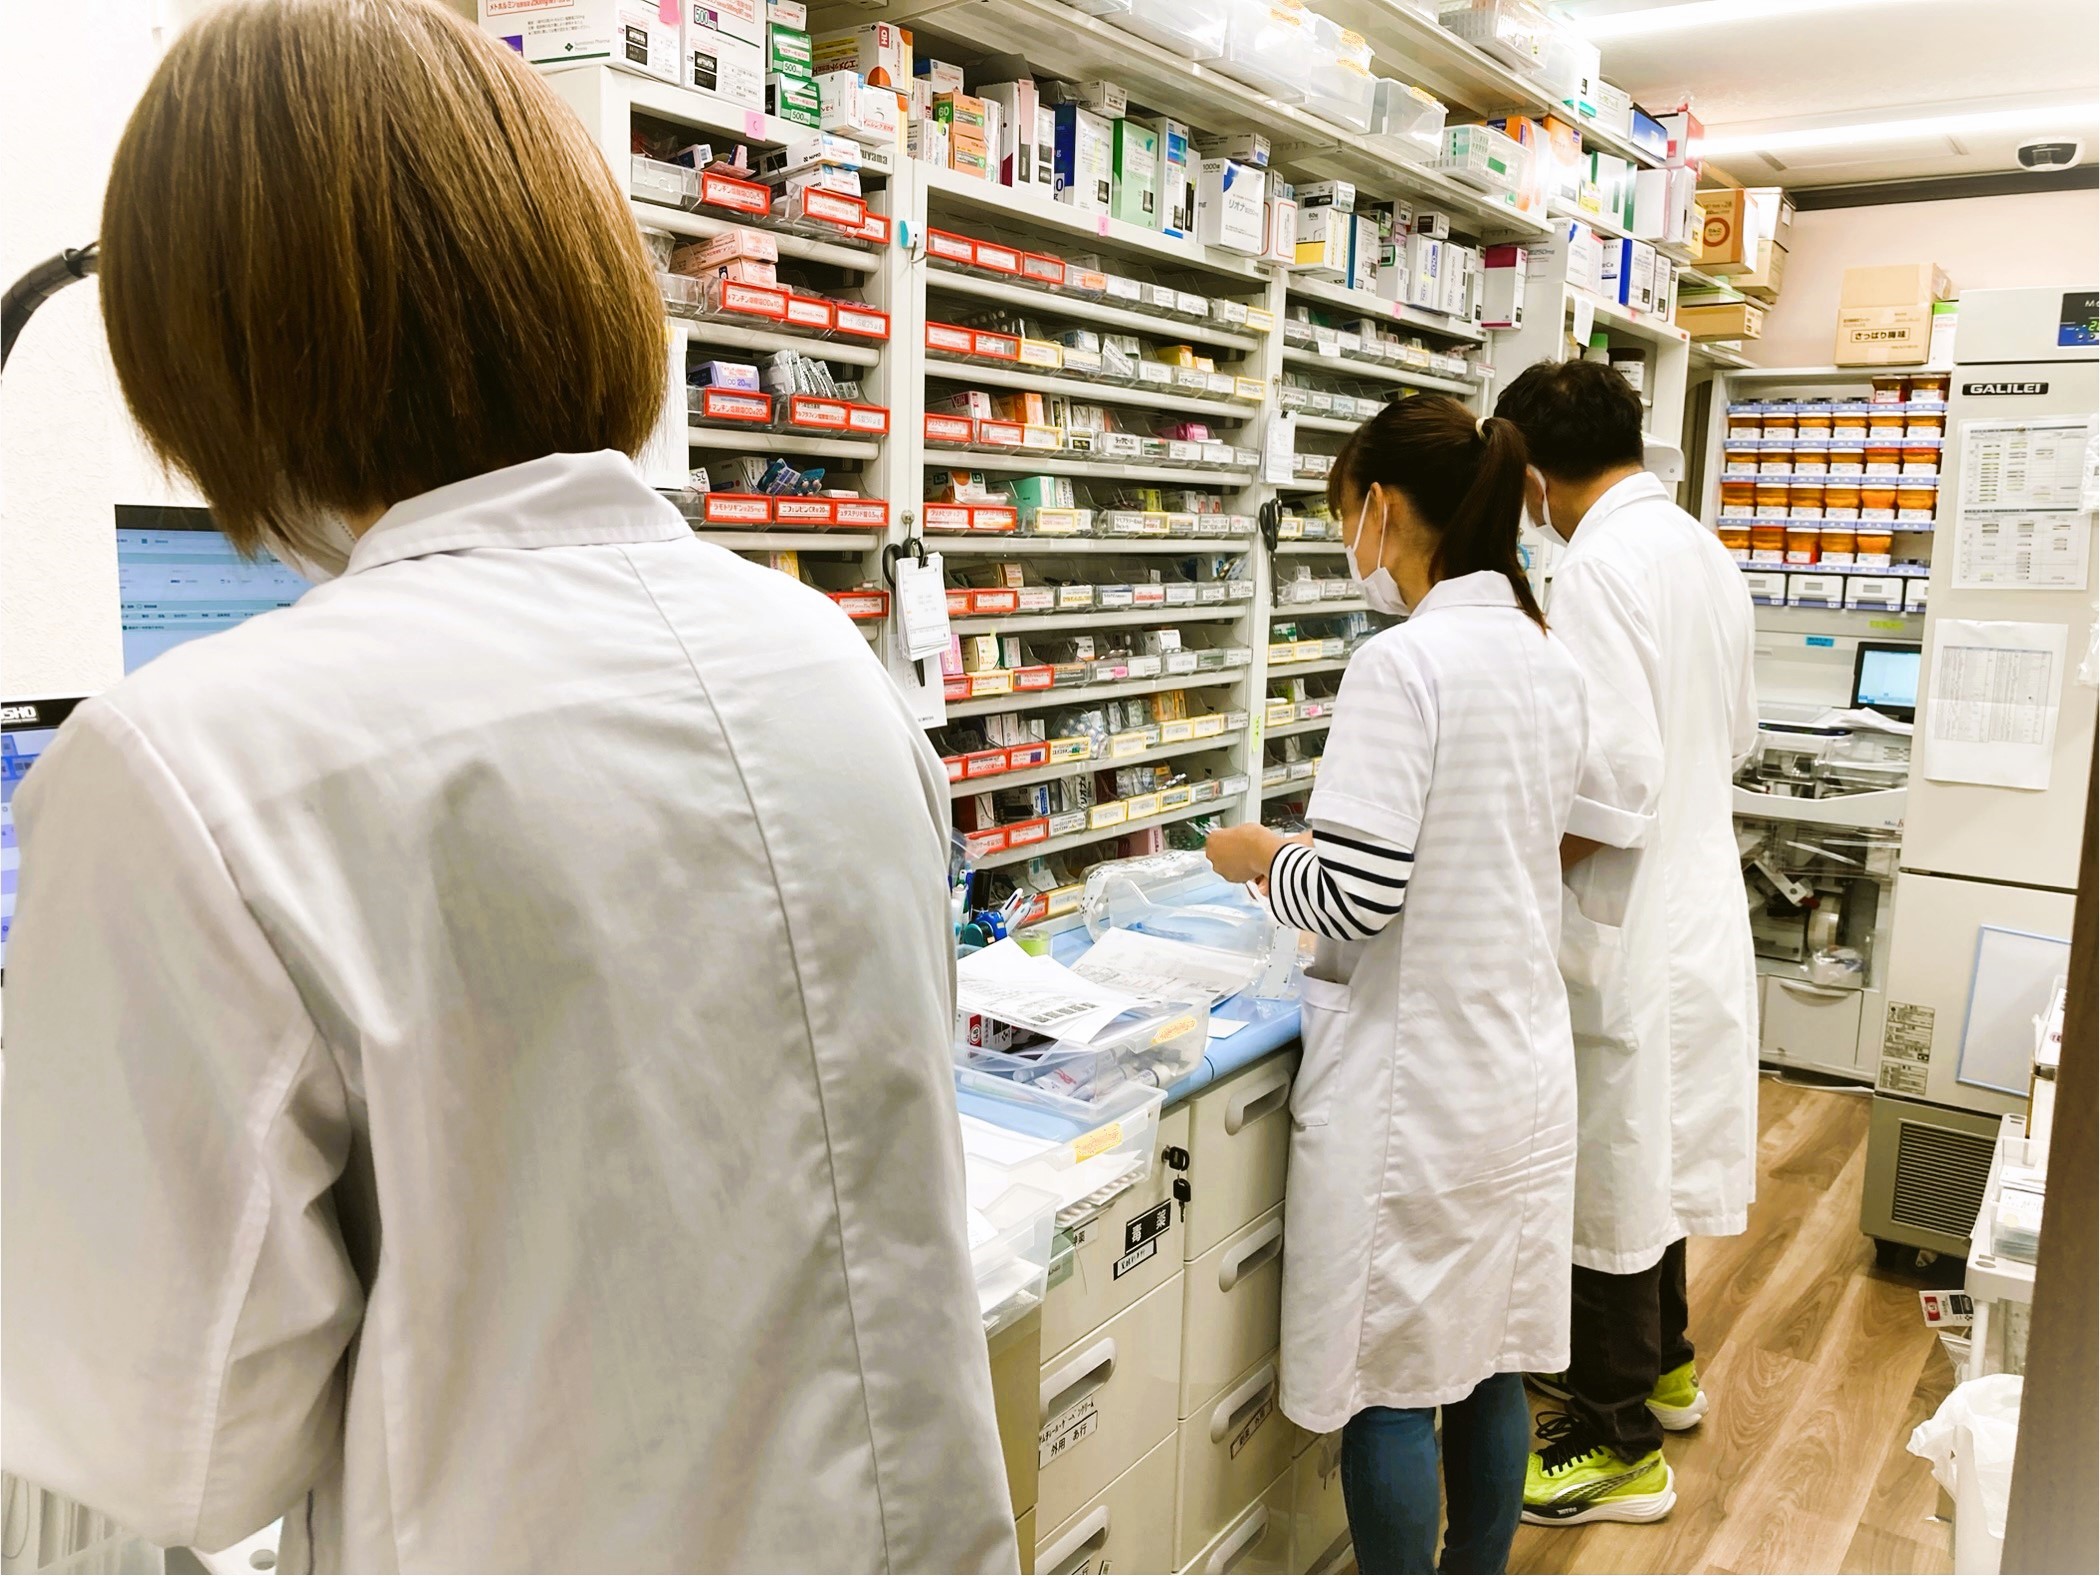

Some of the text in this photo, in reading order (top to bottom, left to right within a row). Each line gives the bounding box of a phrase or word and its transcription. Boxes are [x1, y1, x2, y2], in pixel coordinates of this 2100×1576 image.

[881, 30, 888, 45] HD
[1970, 383, 2042, 395] GALILEI
[1, 705, 37, 720] SHO
[1050, 1437, 1066, 1457] 外用
